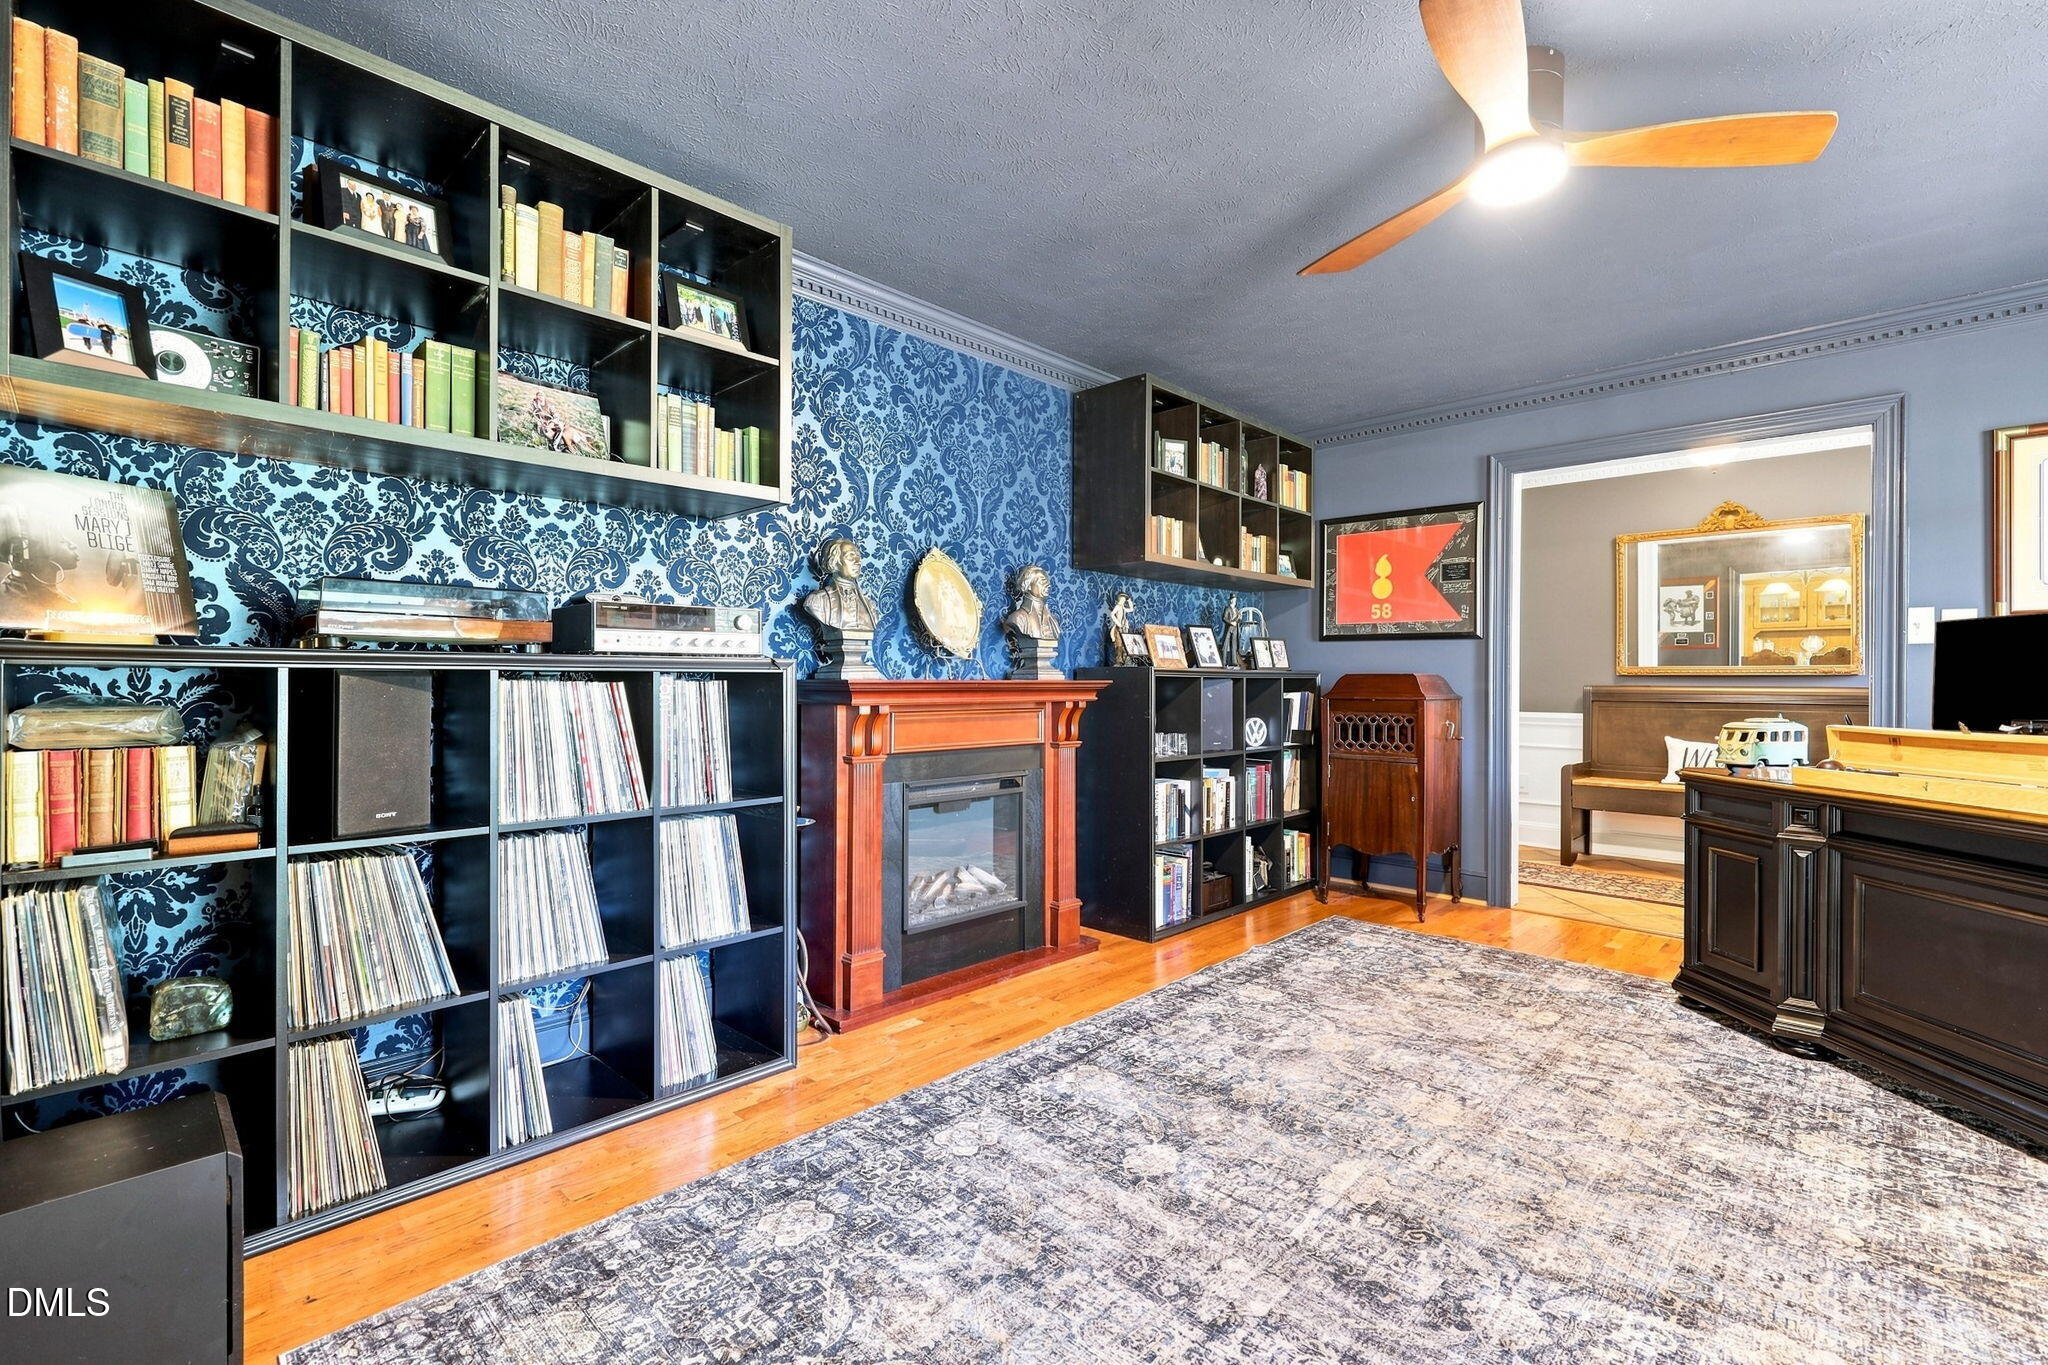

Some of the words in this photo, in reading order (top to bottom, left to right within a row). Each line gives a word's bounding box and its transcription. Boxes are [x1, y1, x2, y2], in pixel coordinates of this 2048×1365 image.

[109, 491, 124, 501] THE
[75, 514, 120, 534] MARY
[125, 521, 131, 536] J
[86, 532, 135, 552] BLIGE
[1371, 603, 1392, 619] 58
